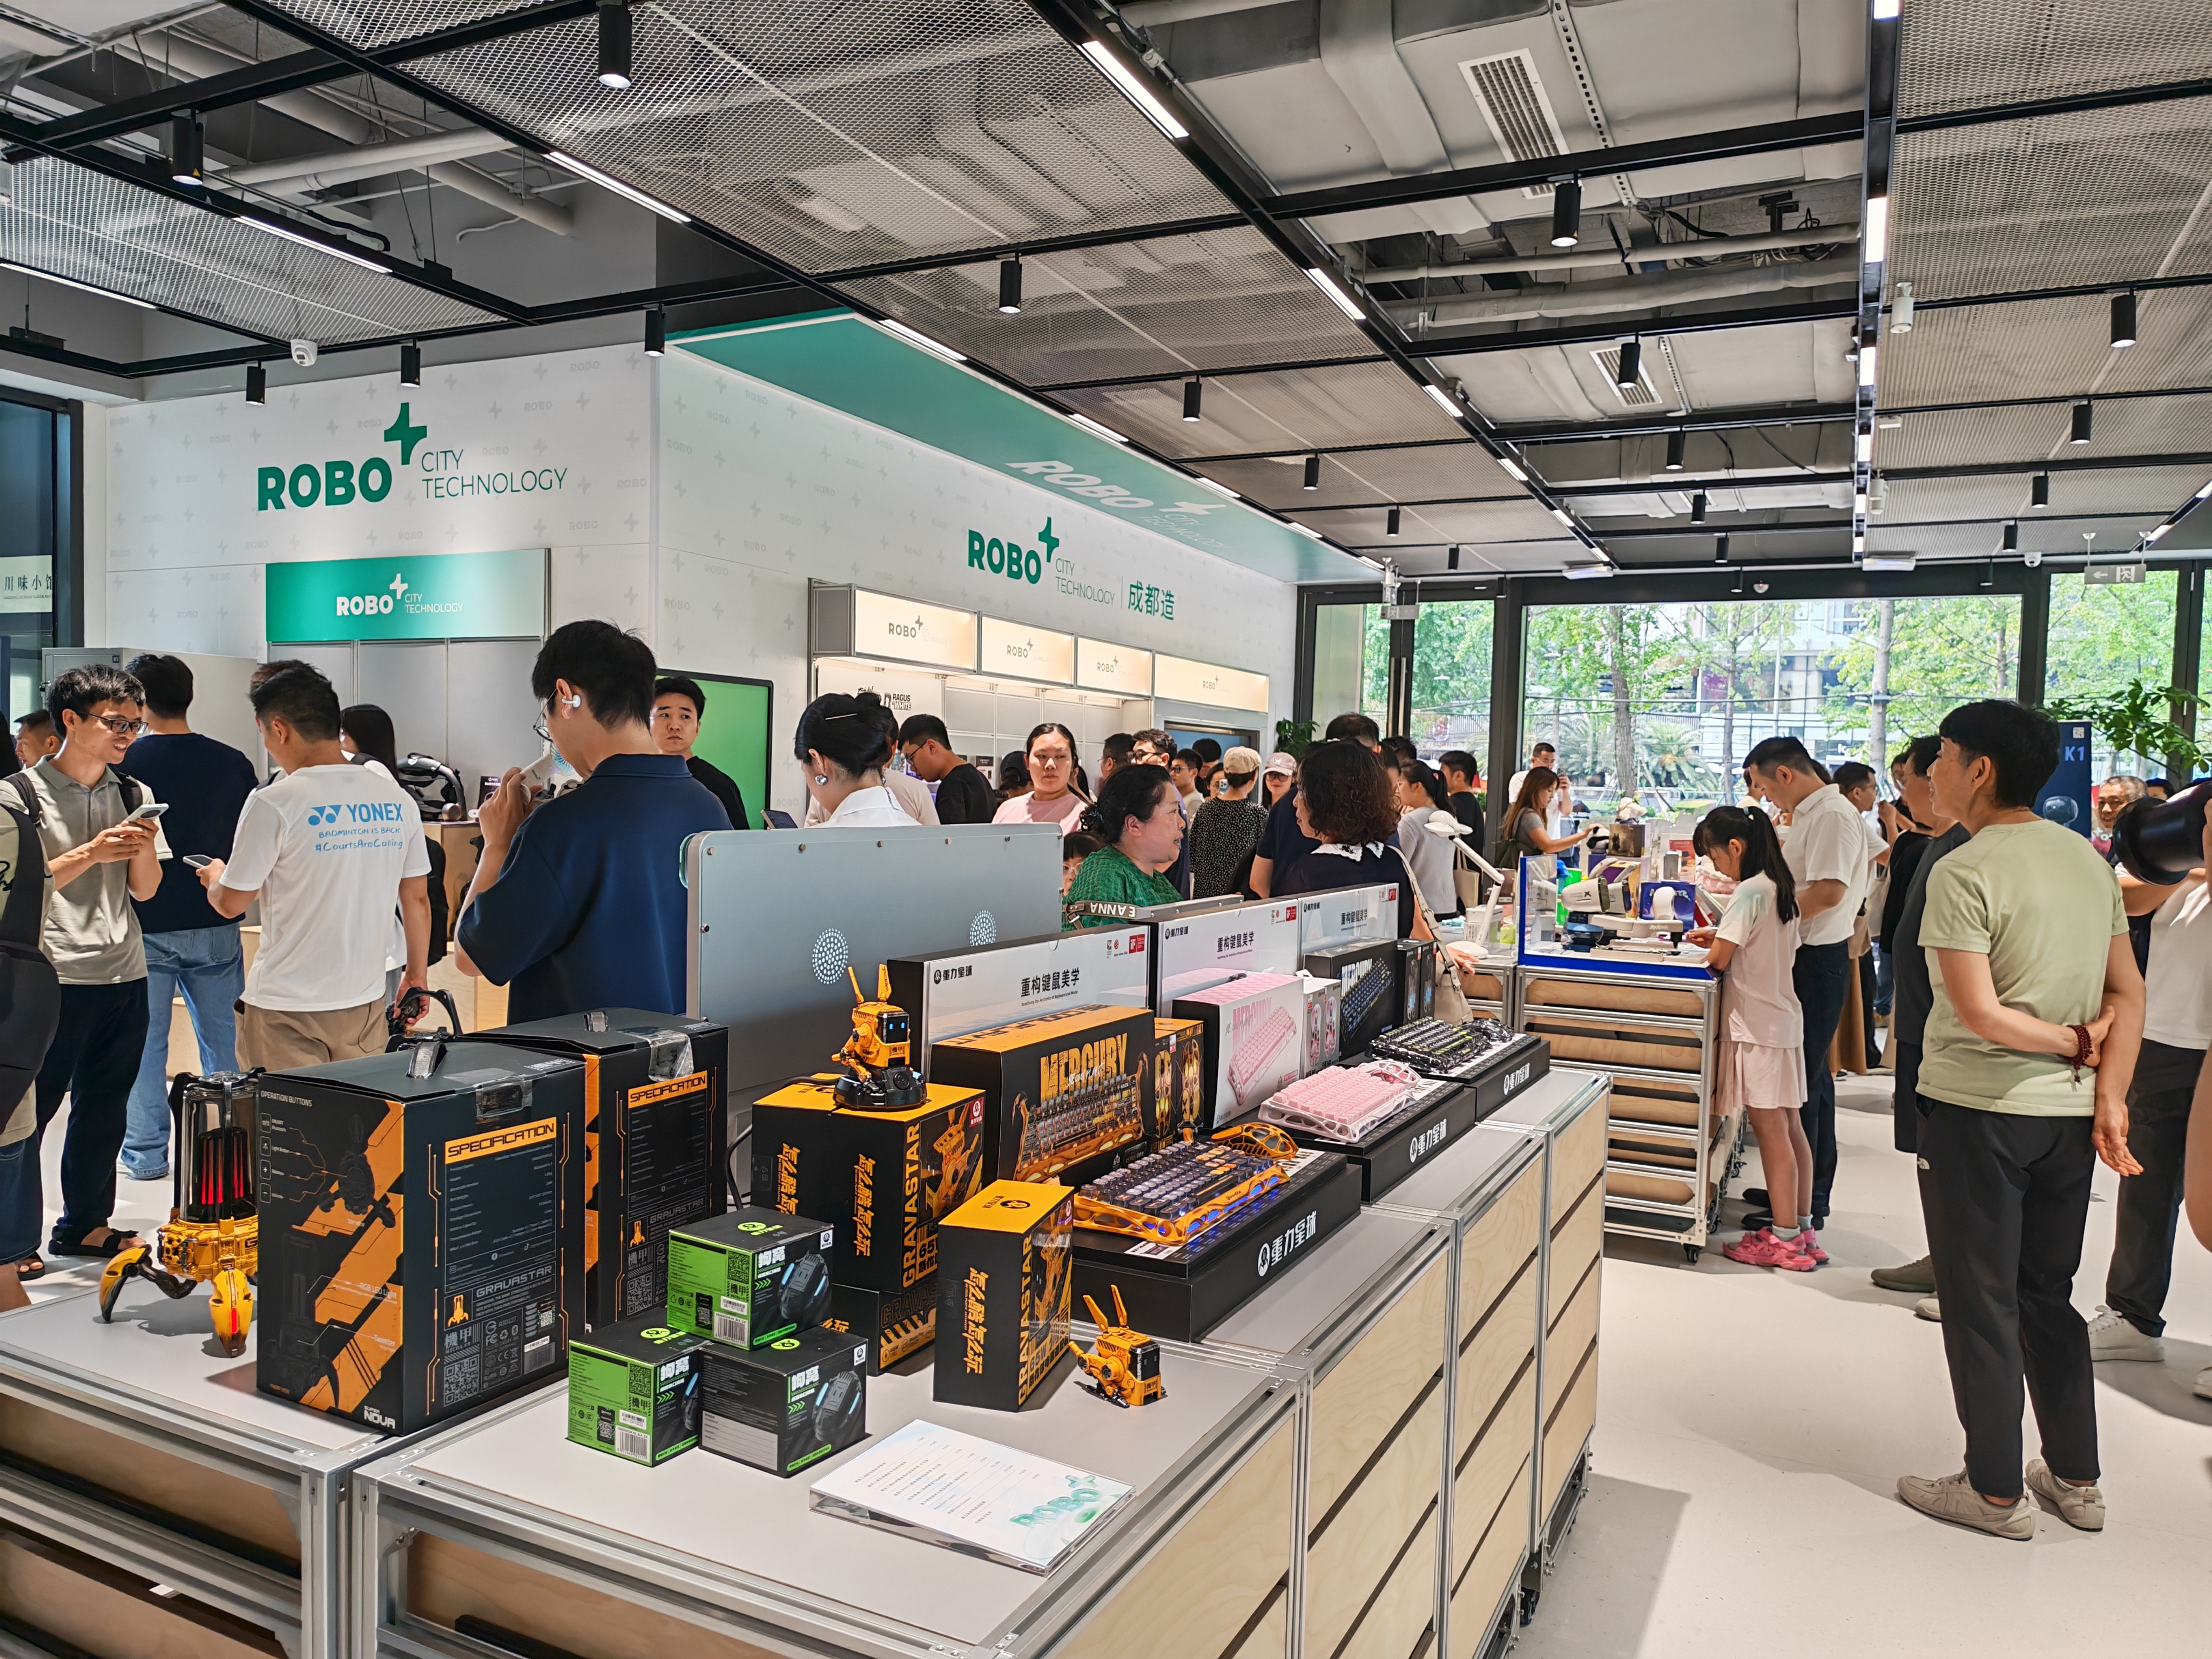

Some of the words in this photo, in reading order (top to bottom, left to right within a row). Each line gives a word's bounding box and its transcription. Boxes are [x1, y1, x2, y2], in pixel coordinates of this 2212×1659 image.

[421, 449, 463, 473] CITY
[258, 457, 392, 511] ROBO
[422, 468, 568, 499] TECHNOLOGY
[1005, 461, 1154, 508] ROBO
[968, 529, 1041, 584] ROBO
[1055, 558, 1075, 576] CITY
[1055, 576, 1115, 606] TECHNOLOGY
[1128, 581, 1175, 621] 成都造
[336, 595, 393, 616] ROBO
[405, 593, 422, 603] CITY
[405, 603, 463, 613] TECHNOLOGY
[888, 622, 916, 638] ROBO
[1007, 645, 1028, 658] ROBO
[1097, 662, 1114, 673] ROBO
[1203, 680, 1215, 690] ROBO
[893, 693, 911, 702] RAGUS
[2065, 746, 2084, 761] K1
[346, 803, 403, 822] YONEX
[319, 829, 369, 838] BADMINTON
[315, 839, 403, 852] #CourtsAreCalling
[1090, 902, 1127, 915] ANNA
[1217, 931, 1254, 952] 重构键鼠美学
[943, 965, 973, 981] 重力星球
[1021, 967, 1080, 997] 重构键鼠美学
[1041, 1033, 1128, 1101] MERCURY
[261, 1090, 288, 1102] OPERATION
[289, 1096, 312, 1107] BUTTONS
[630, 1075, 706, 1103] SPECIFICATION
[448, 1123, 554, 1157] SPECIFICATION
[1418, 1118, 1447, 1157] 重力星球
[650, 1198, 704, 1224] GRAVASTAR
[852, 1154, 875, 1256] 怎么酷怎么玩
[903, 1123, 920, 1288] GRAVASTAR
[1271, 1210, 1317, 1266] 重力星球
[360, 1283, 371, 1292] RGB
[372, 1286, 382, 1294] LED
[476, 1265, 552, 1297] GRAVASTAR
[962, 1267, 989, 1375] 怎么酷怎么玩
[1018, 1235, 1032, 1402] GRAVASTAR
[446, 1326, 471, 1349] 機甲
[364, 1406, 380, 1414] SUPER
[632, 1396, 649, 1410] 機甲
[363, 1410, 396, 1429] NOVA
